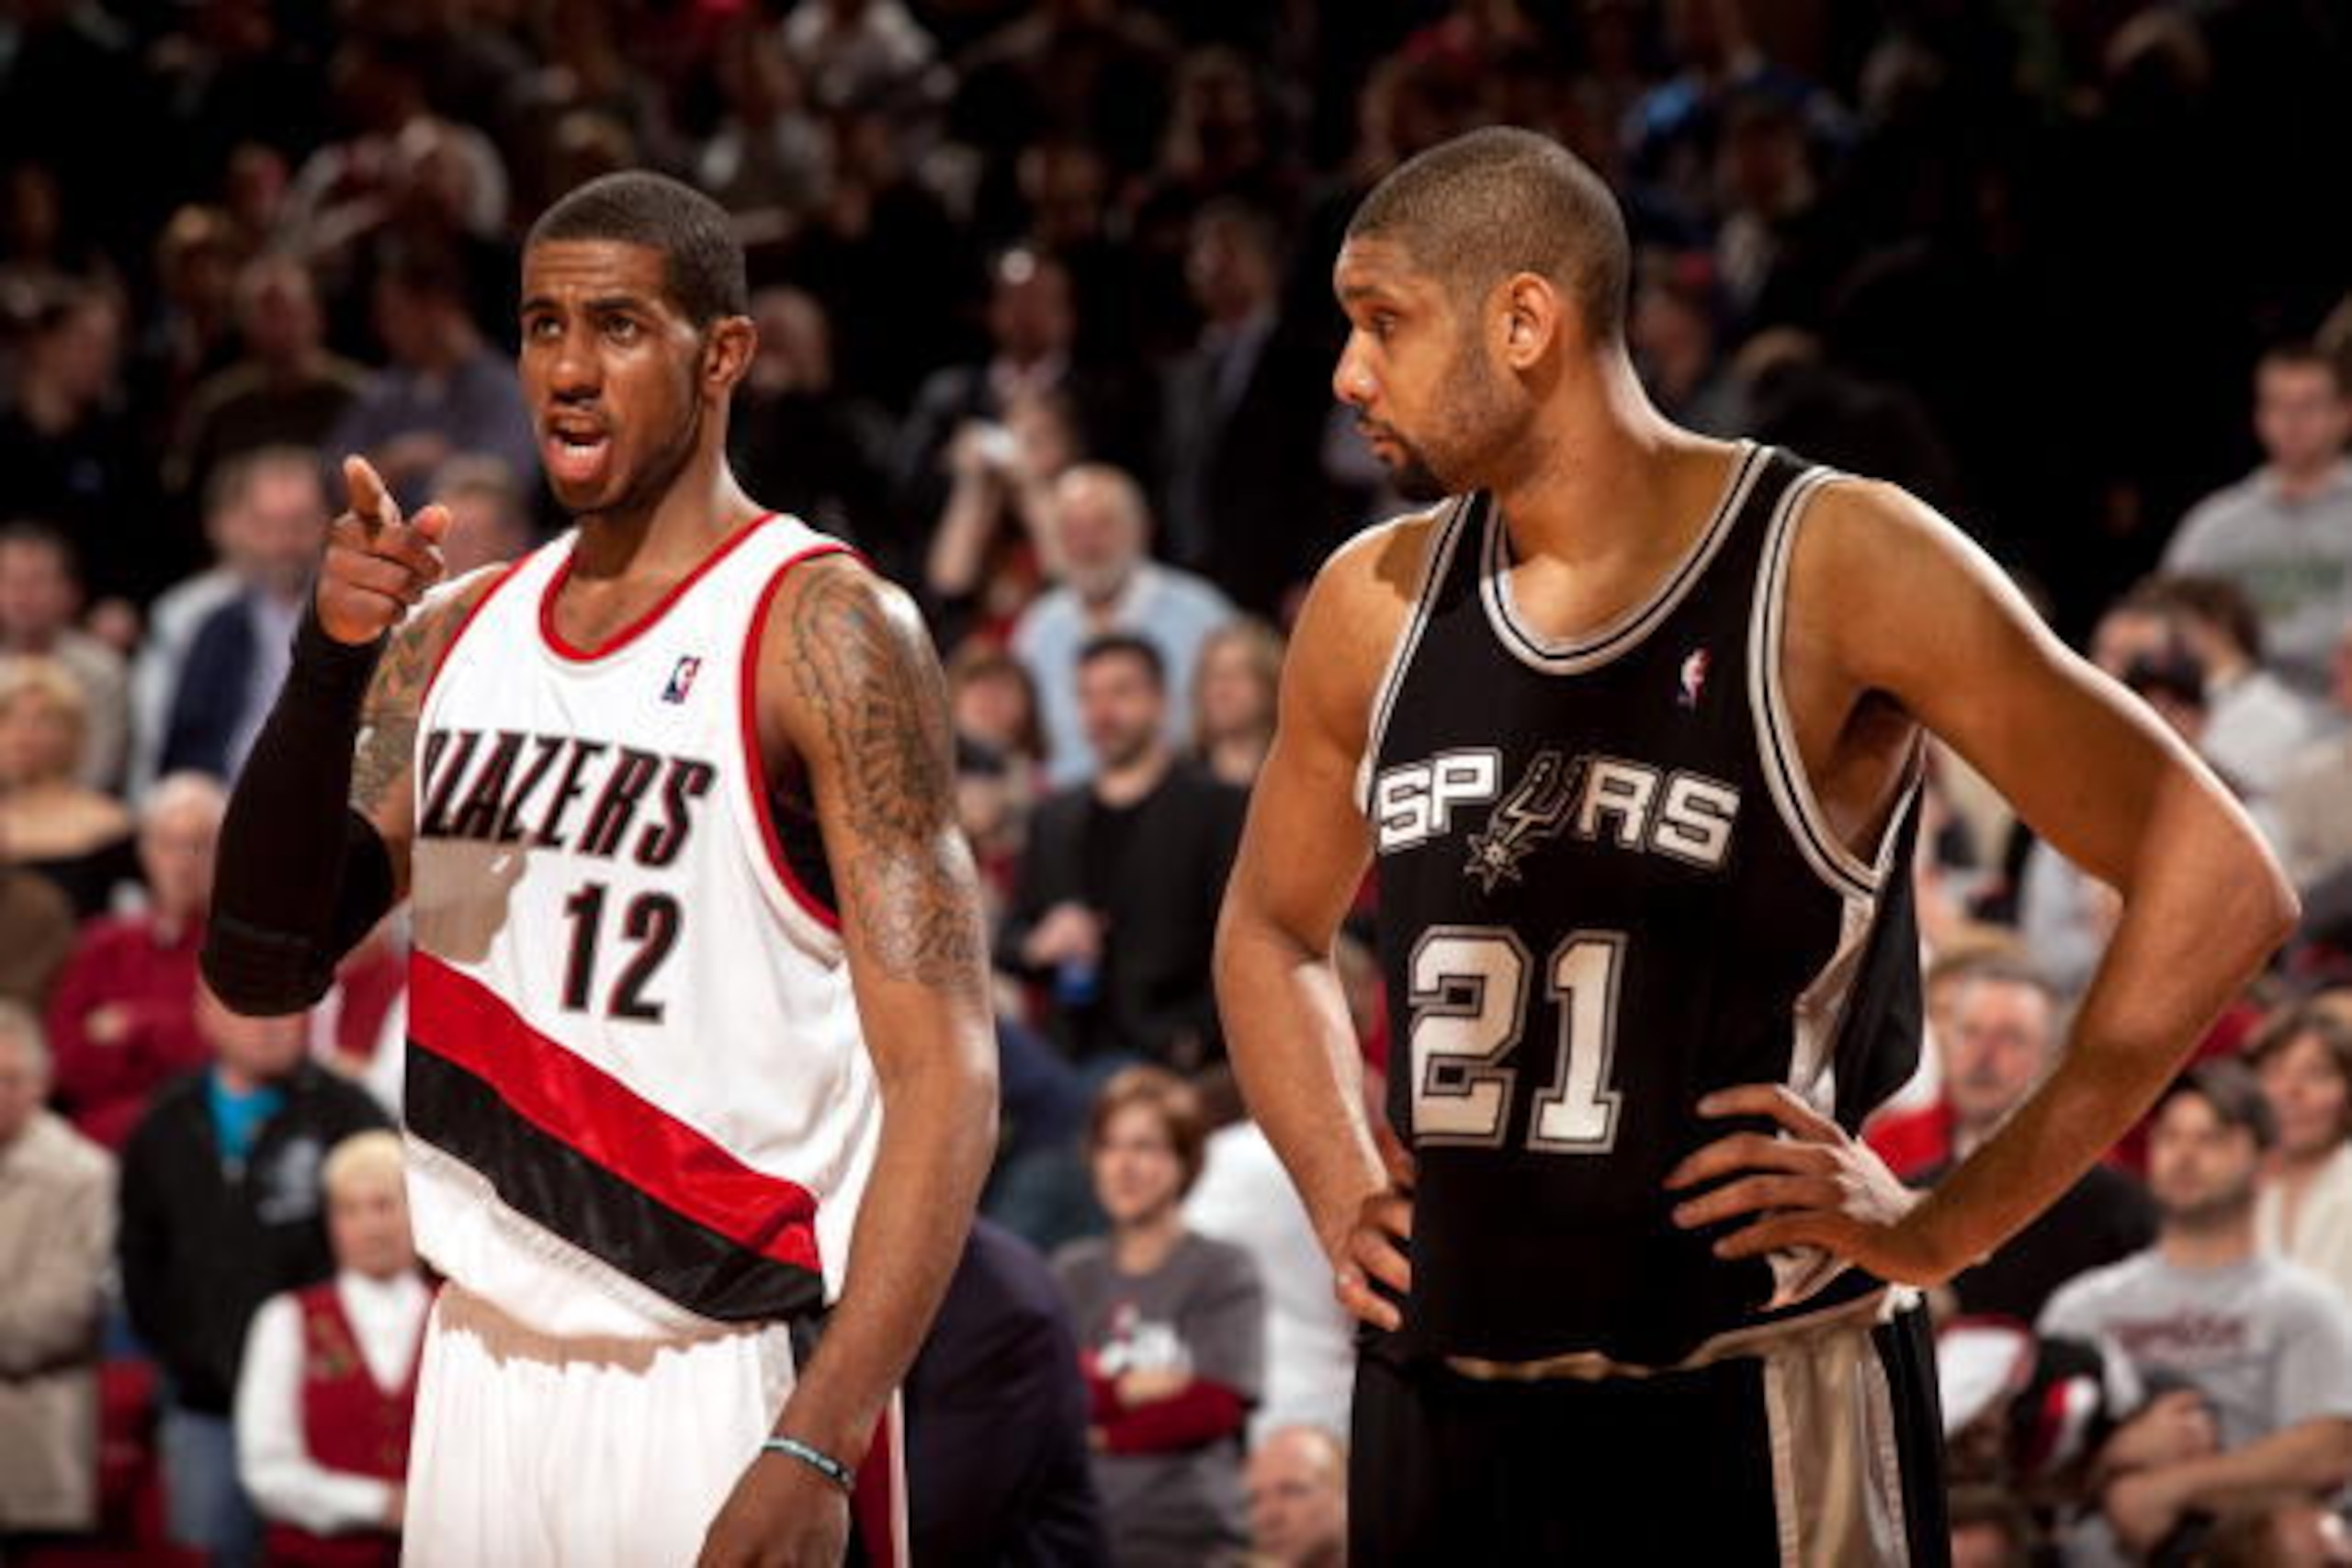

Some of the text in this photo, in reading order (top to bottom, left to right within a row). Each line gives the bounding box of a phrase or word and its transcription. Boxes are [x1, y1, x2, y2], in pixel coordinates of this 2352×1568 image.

[1374, 746, 1741, 893] SPURS
[560, 882, 684, 1025] 12
[1408, 924, 1629, 1154] 21
